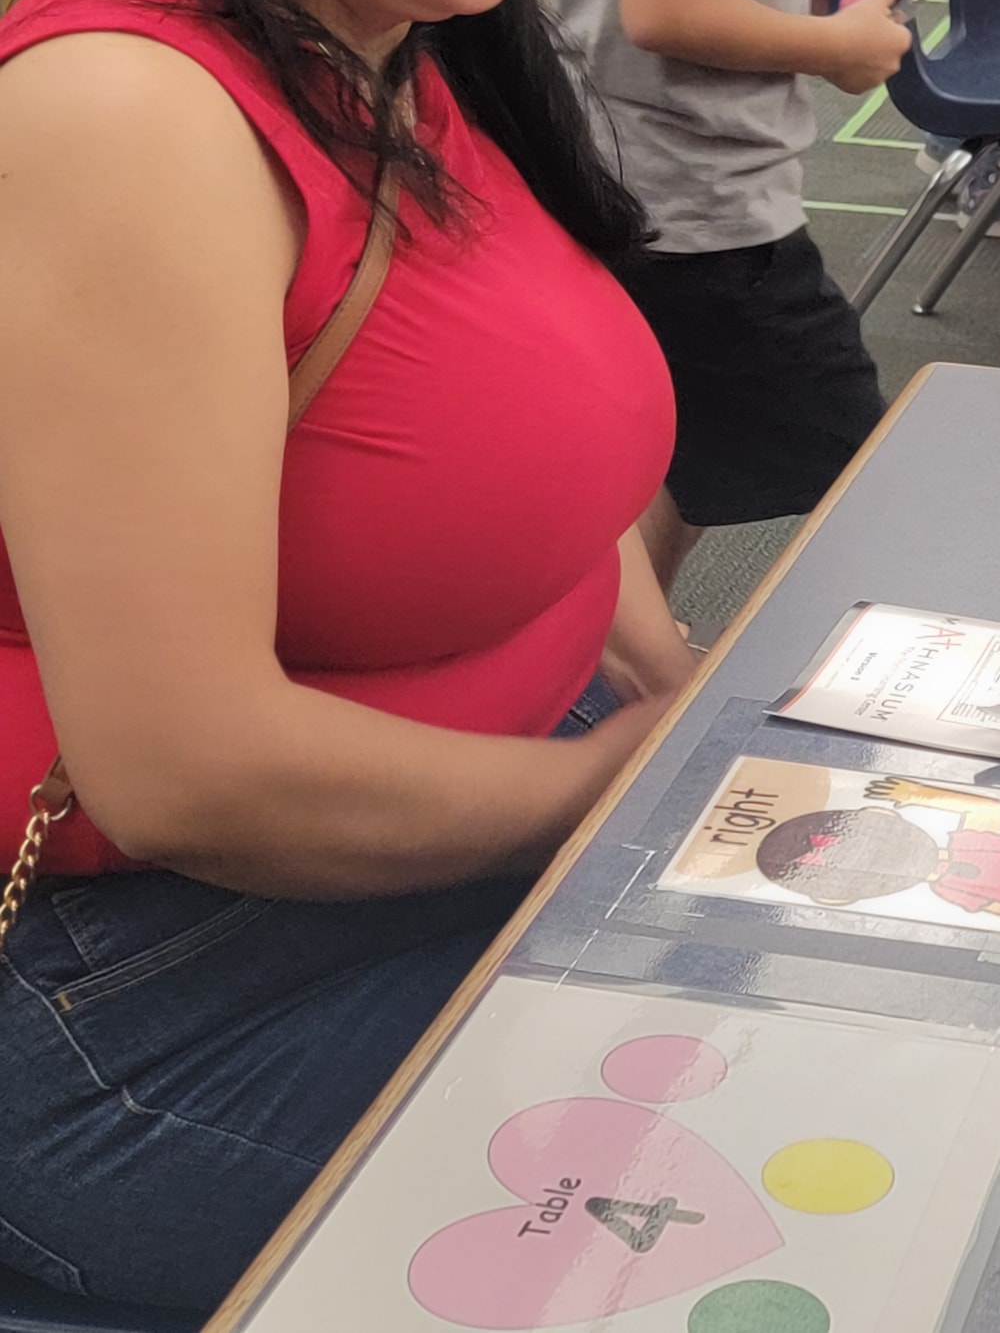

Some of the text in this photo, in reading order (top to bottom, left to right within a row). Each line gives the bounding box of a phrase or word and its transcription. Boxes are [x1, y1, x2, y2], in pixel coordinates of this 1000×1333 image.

[856, 652, 878, 676] Version
[709, 787, 780, 846] right
[517, 1177, 582, 1240] Table
[584, 1196, 706, 1253] 4
